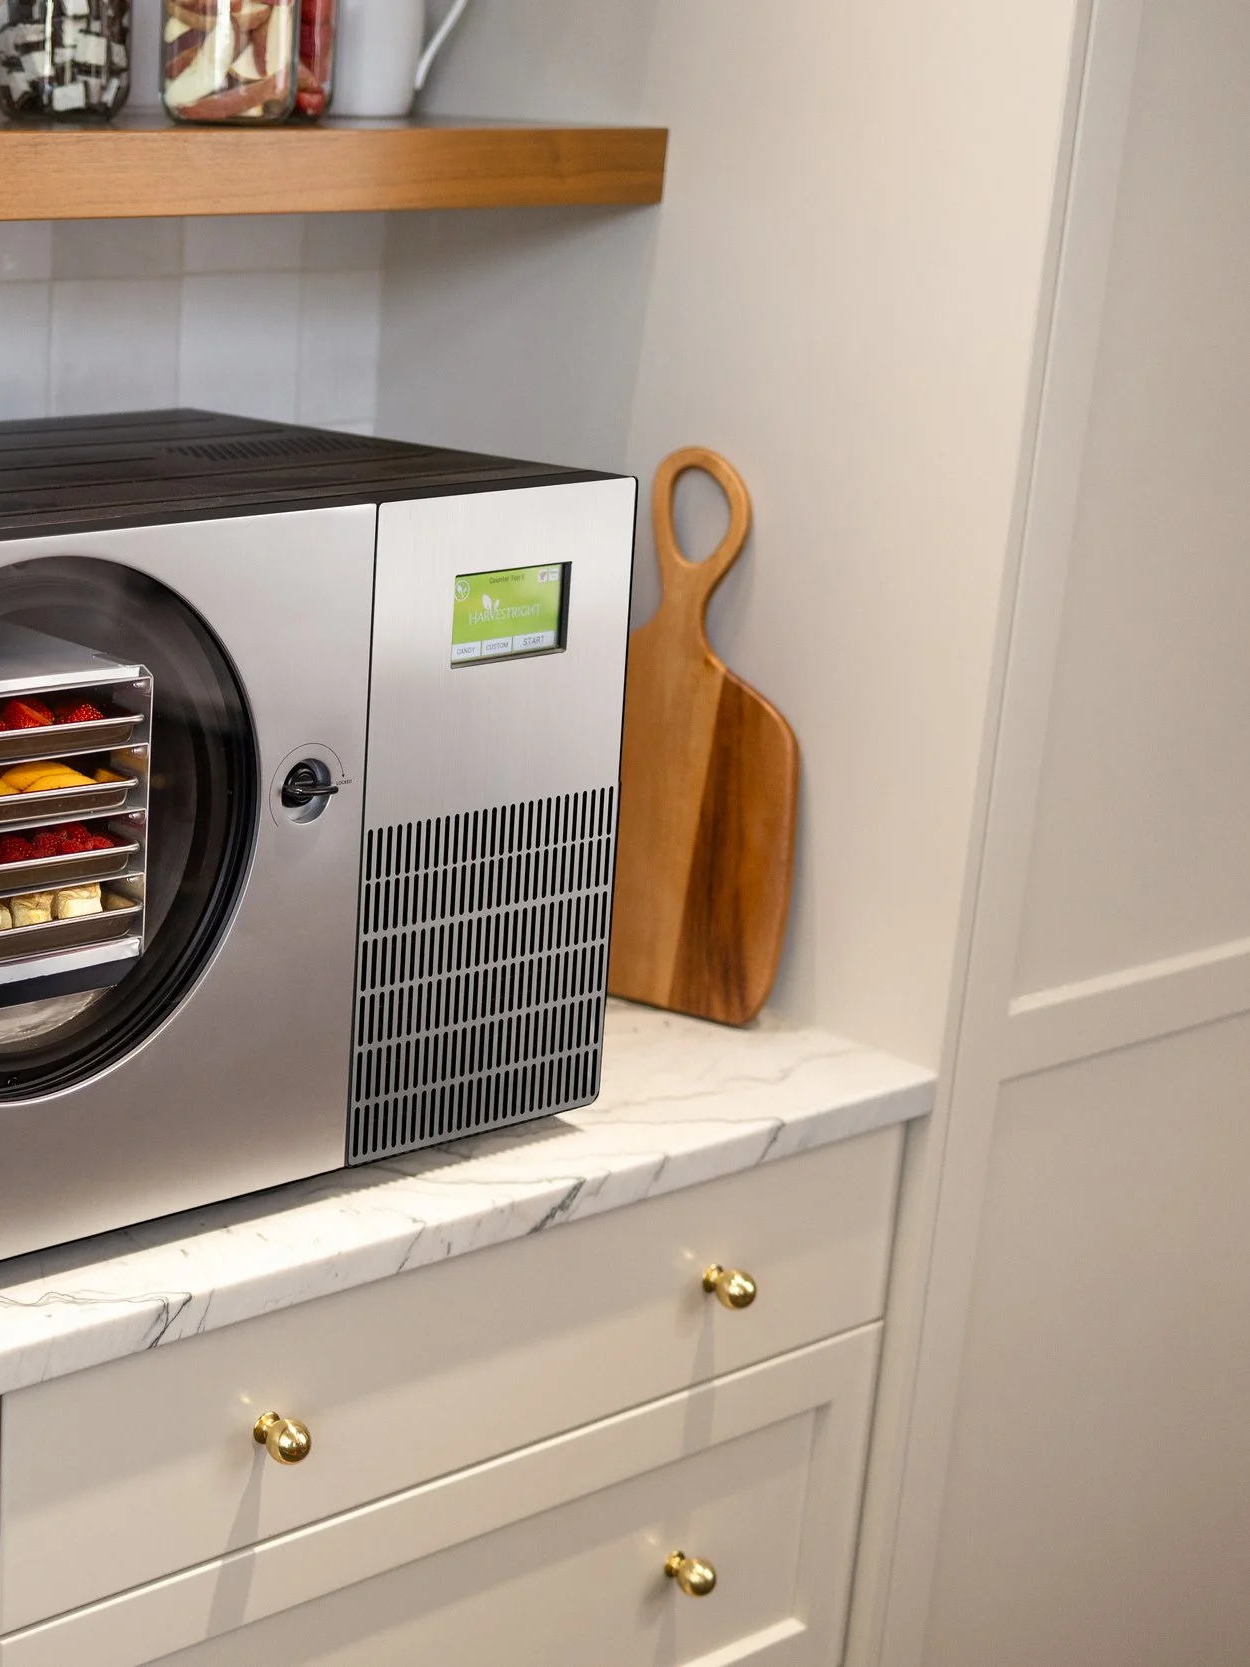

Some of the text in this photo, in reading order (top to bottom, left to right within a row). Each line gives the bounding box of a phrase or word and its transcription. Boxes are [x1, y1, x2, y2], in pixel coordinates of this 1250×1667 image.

[468, 604, 541, 625] HARVESTRIGHT
[522, 635, 546, 647] START
[456, 647, 476, 656] CANDY
[485, 642, 509, 651] CUSTOM
